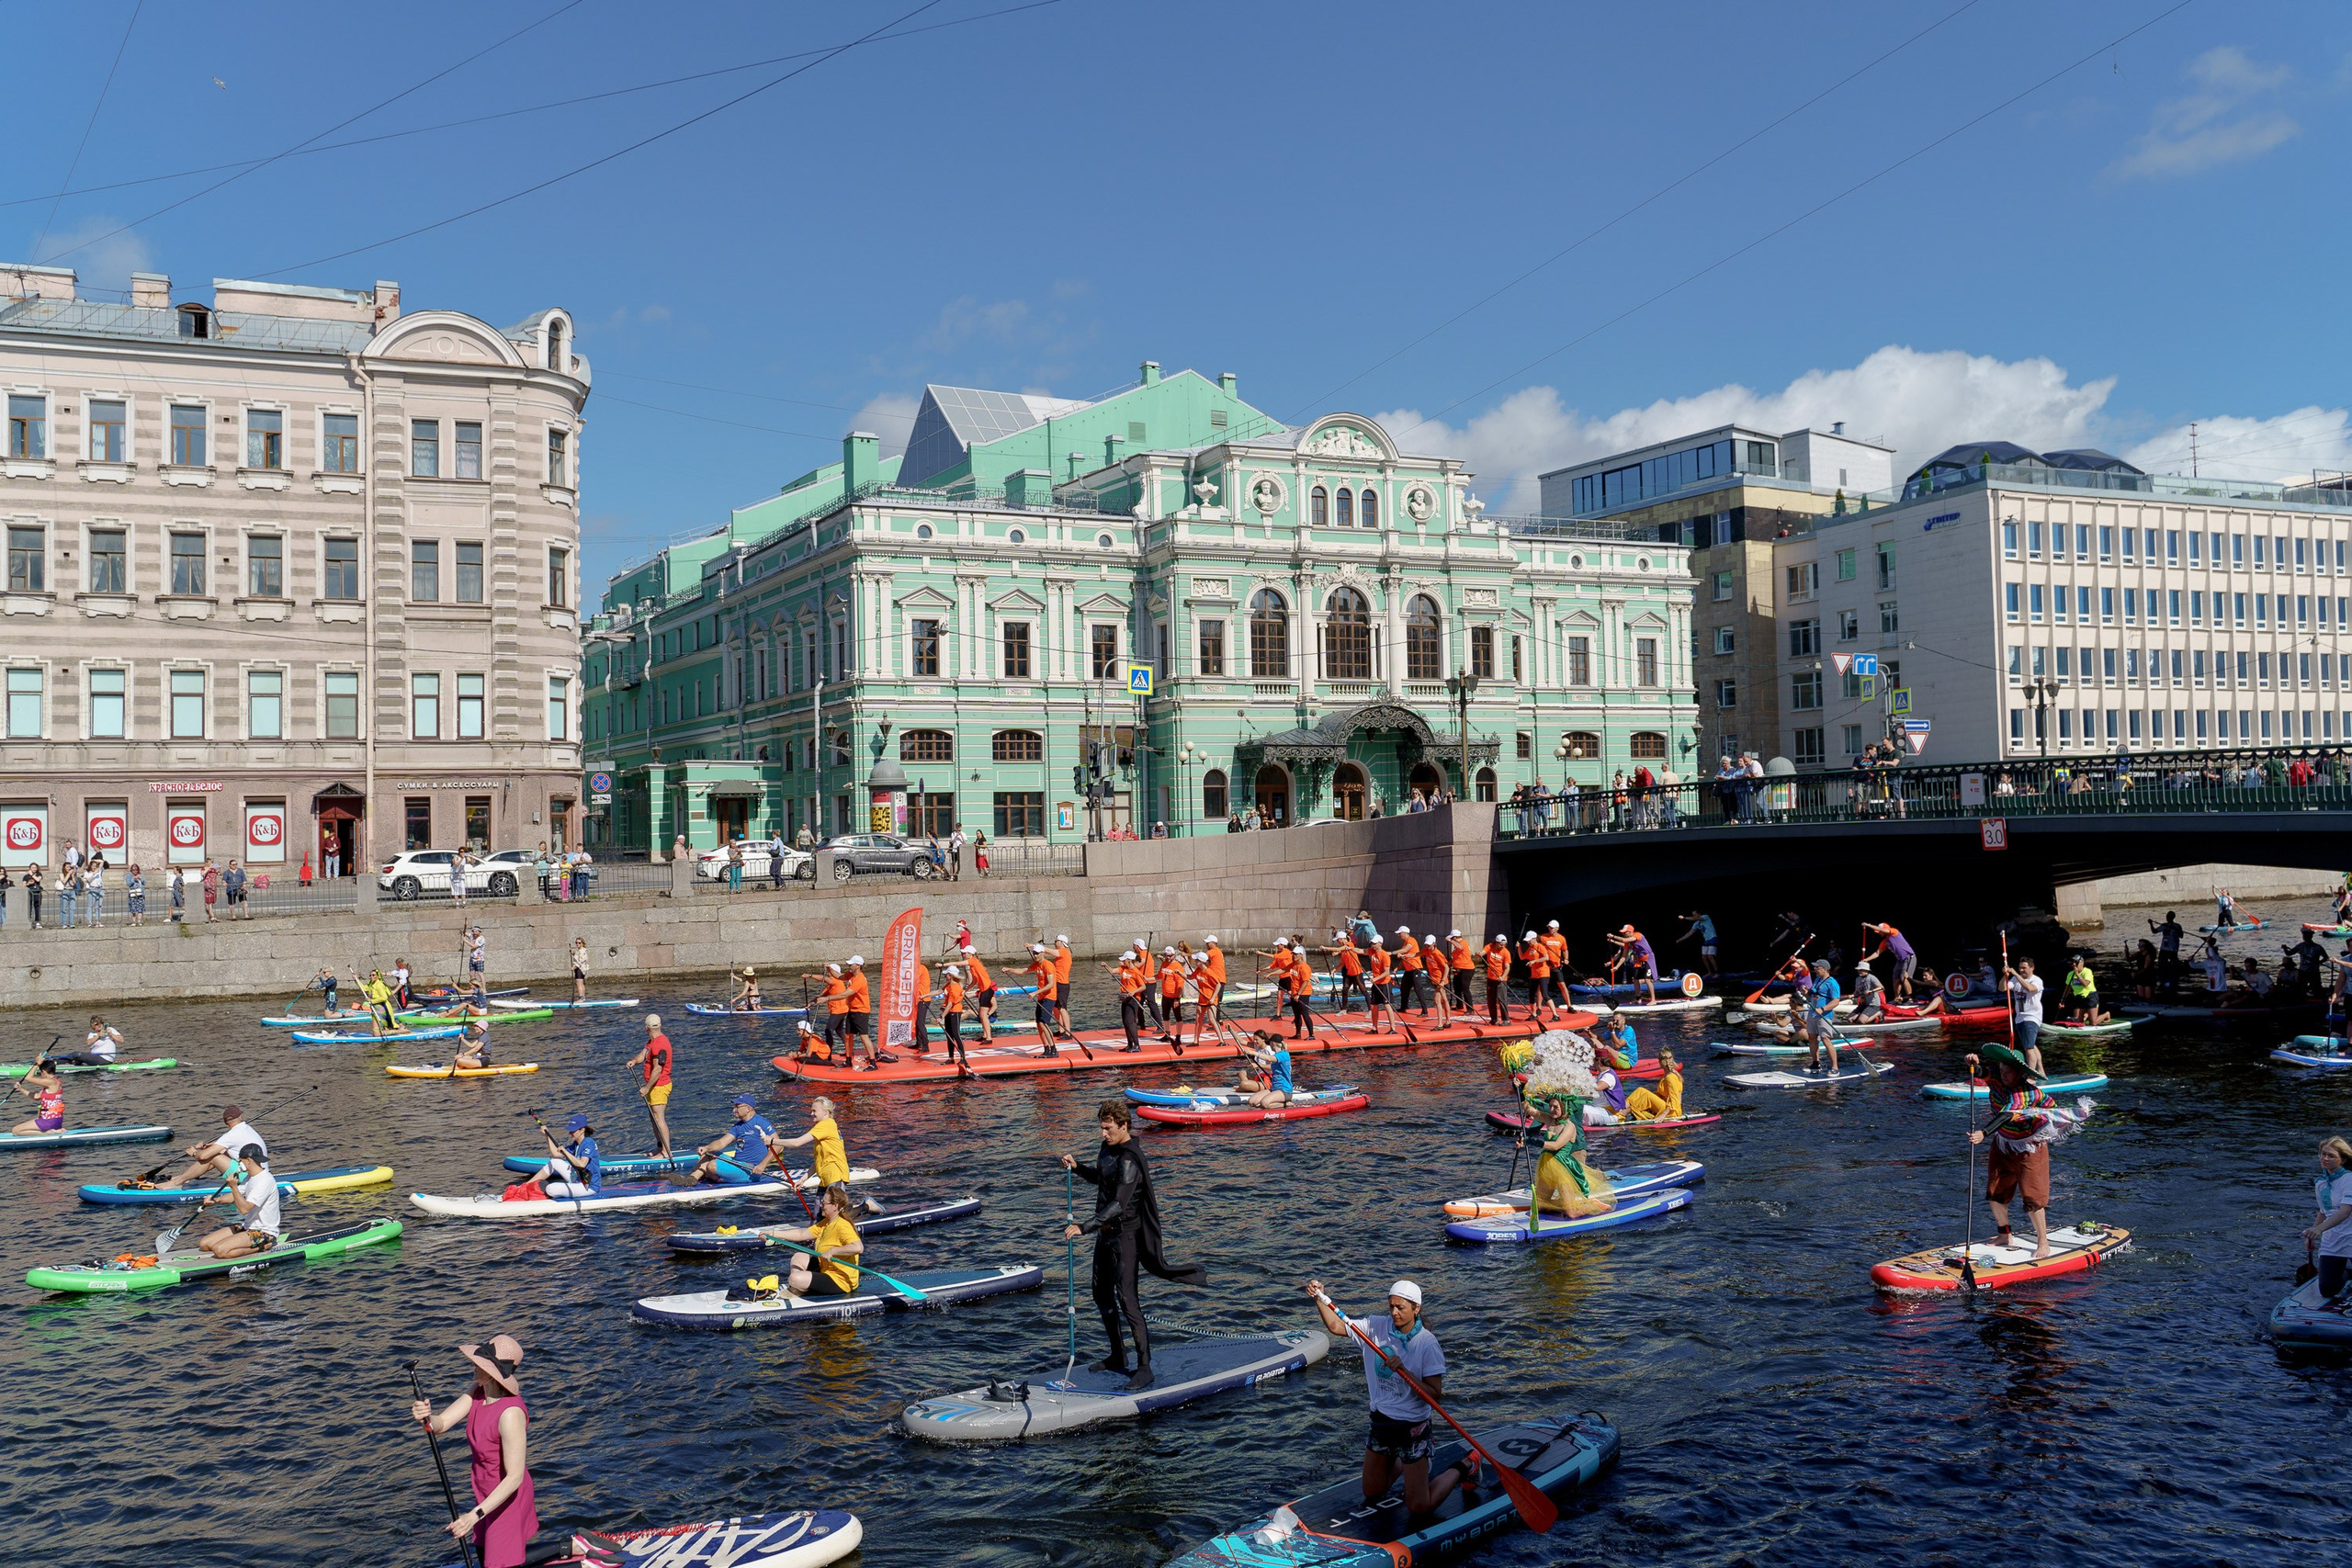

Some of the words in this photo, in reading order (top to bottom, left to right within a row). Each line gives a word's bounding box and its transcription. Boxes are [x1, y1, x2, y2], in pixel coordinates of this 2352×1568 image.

[397, 782, 427, 790] СУМКИ
[442, 781, 499, 789] АКСЕССУАРЫ
[12, 827, 37, 840] К&Б
[96, 827, 119, 840] К&Б
[176, 825, 199, 838] К&Б
[255, 823, 277, 836] К&Б
[1984, 829, 2003, 844] 3.0
[1689, 977, 1698, 990] Д
[1953, 977, 1963, 991] Д
[746, 1314, 781, 1323] GLADIATOR
[1255, 1366, 1286, 1382] GLADIATOR
